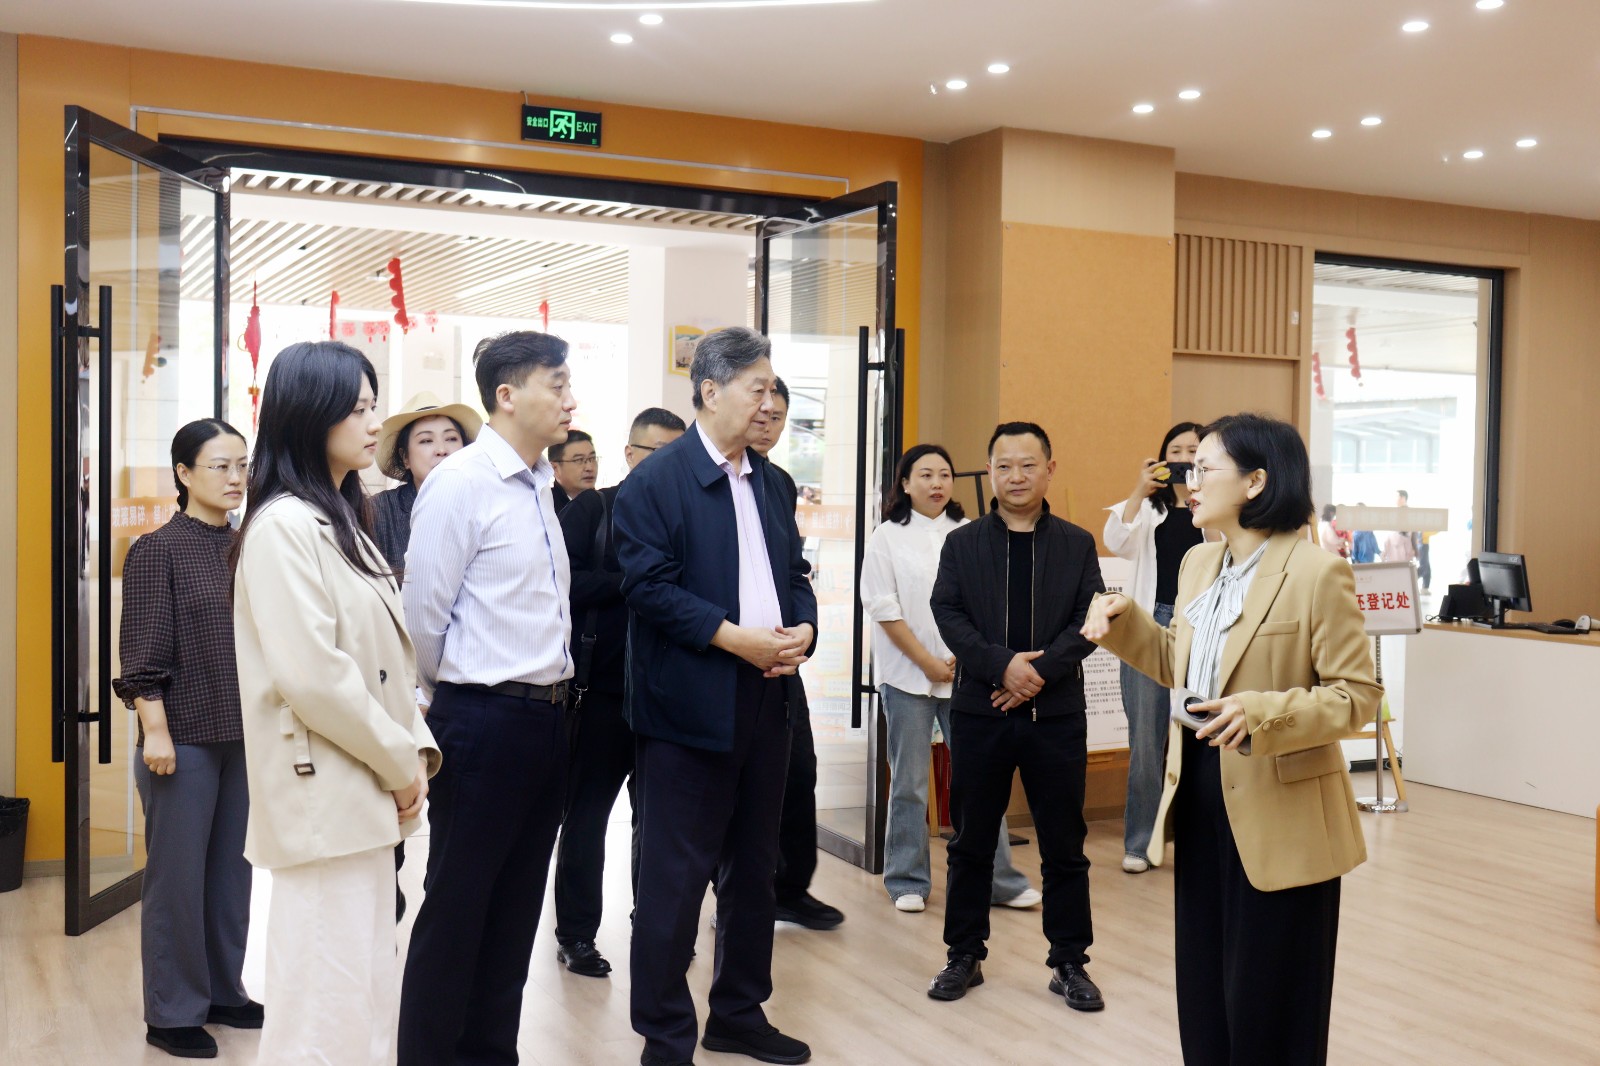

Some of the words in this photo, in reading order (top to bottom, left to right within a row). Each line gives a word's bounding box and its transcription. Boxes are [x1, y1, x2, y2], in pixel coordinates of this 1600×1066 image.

[526, 116, 549, 128] 安全出口
[576, 121, 598, 134] EXIT
